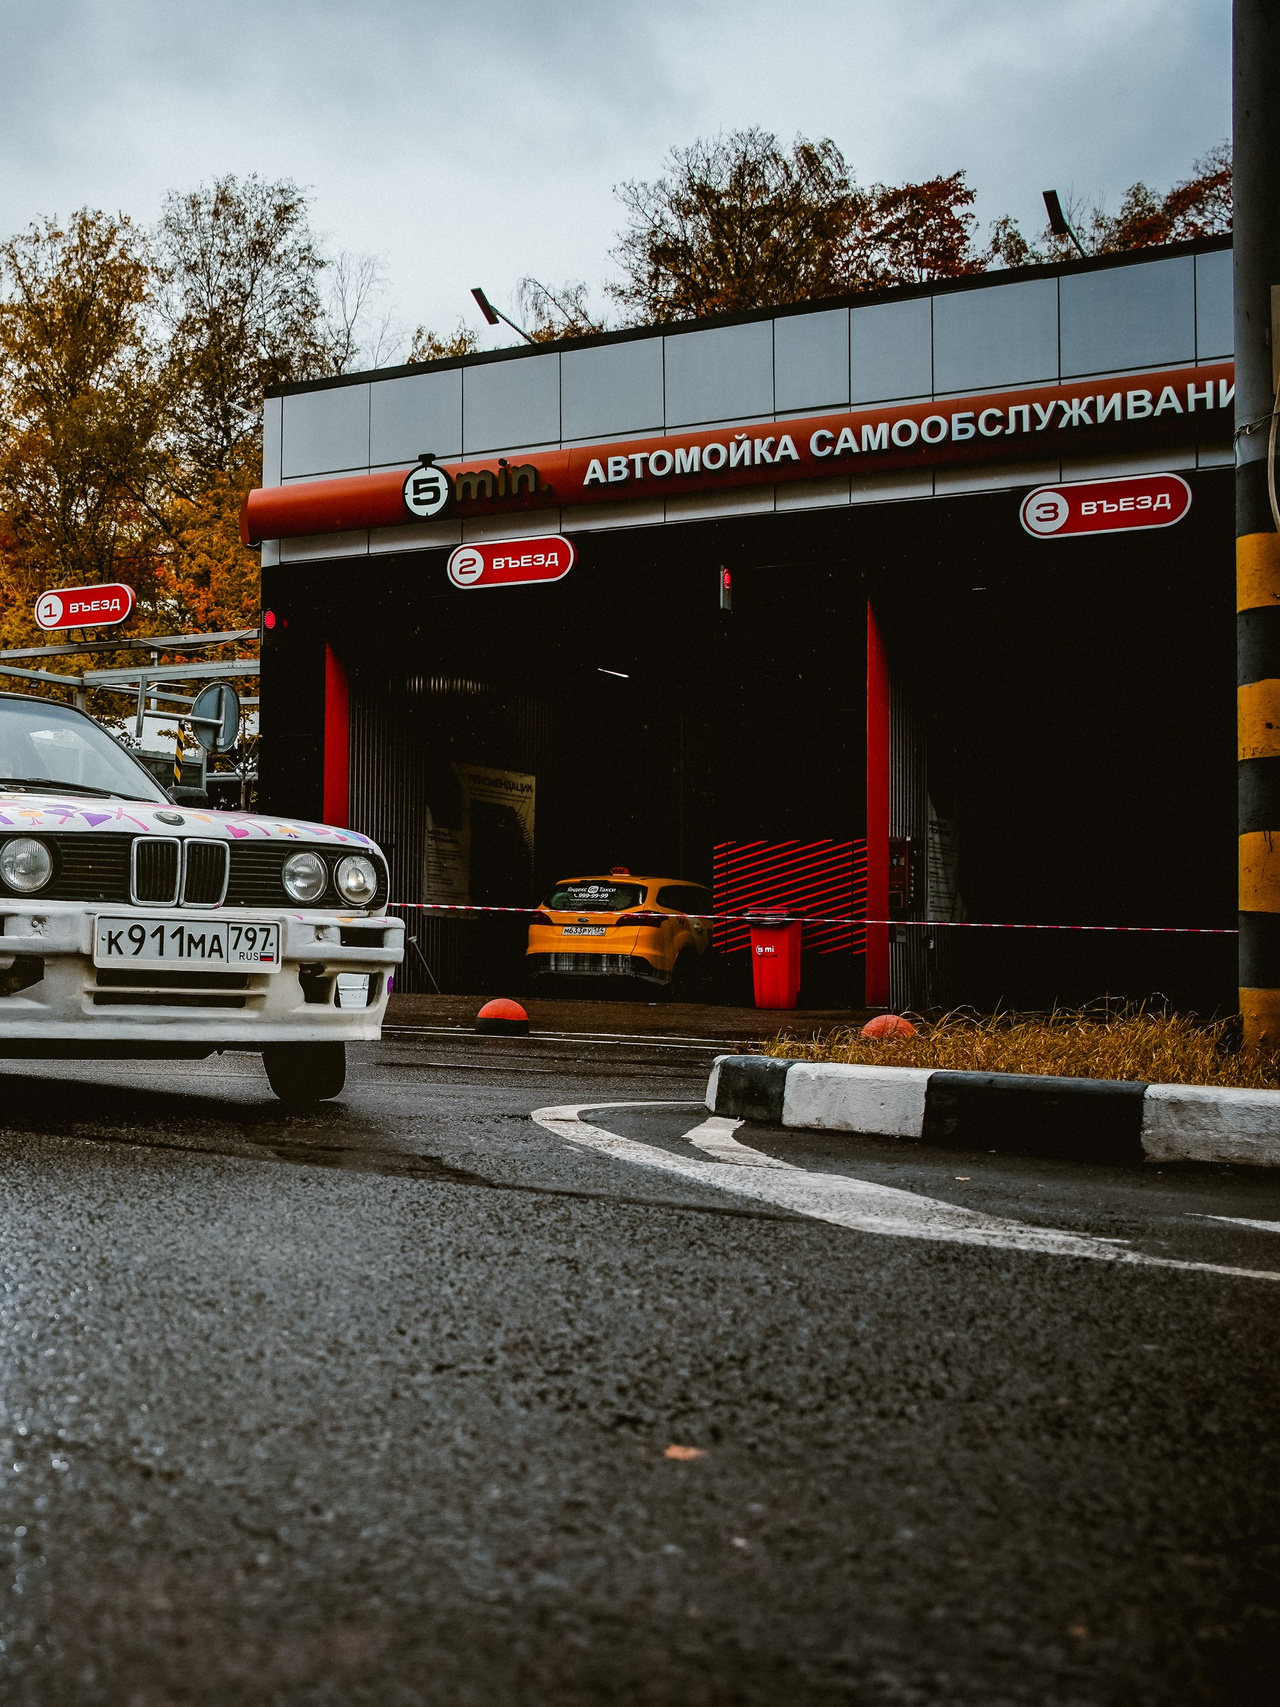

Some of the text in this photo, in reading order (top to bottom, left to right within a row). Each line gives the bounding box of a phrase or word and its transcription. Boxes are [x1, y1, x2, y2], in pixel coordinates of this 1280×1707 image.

[583, 433, 801, 486] АВТОМОЙКА
[412, 476, 442, 506] 5
[1035, 493, 1172, 523] 3 ВЪЕЗД
[458, 552, 559, 575] 2 ВЪЕЗД
[43, 598, 121, 618] 1 ВЪЕЗД
[106, 923, 272, 959] К911МА 797
[238, 951, 260, 961] RUS
